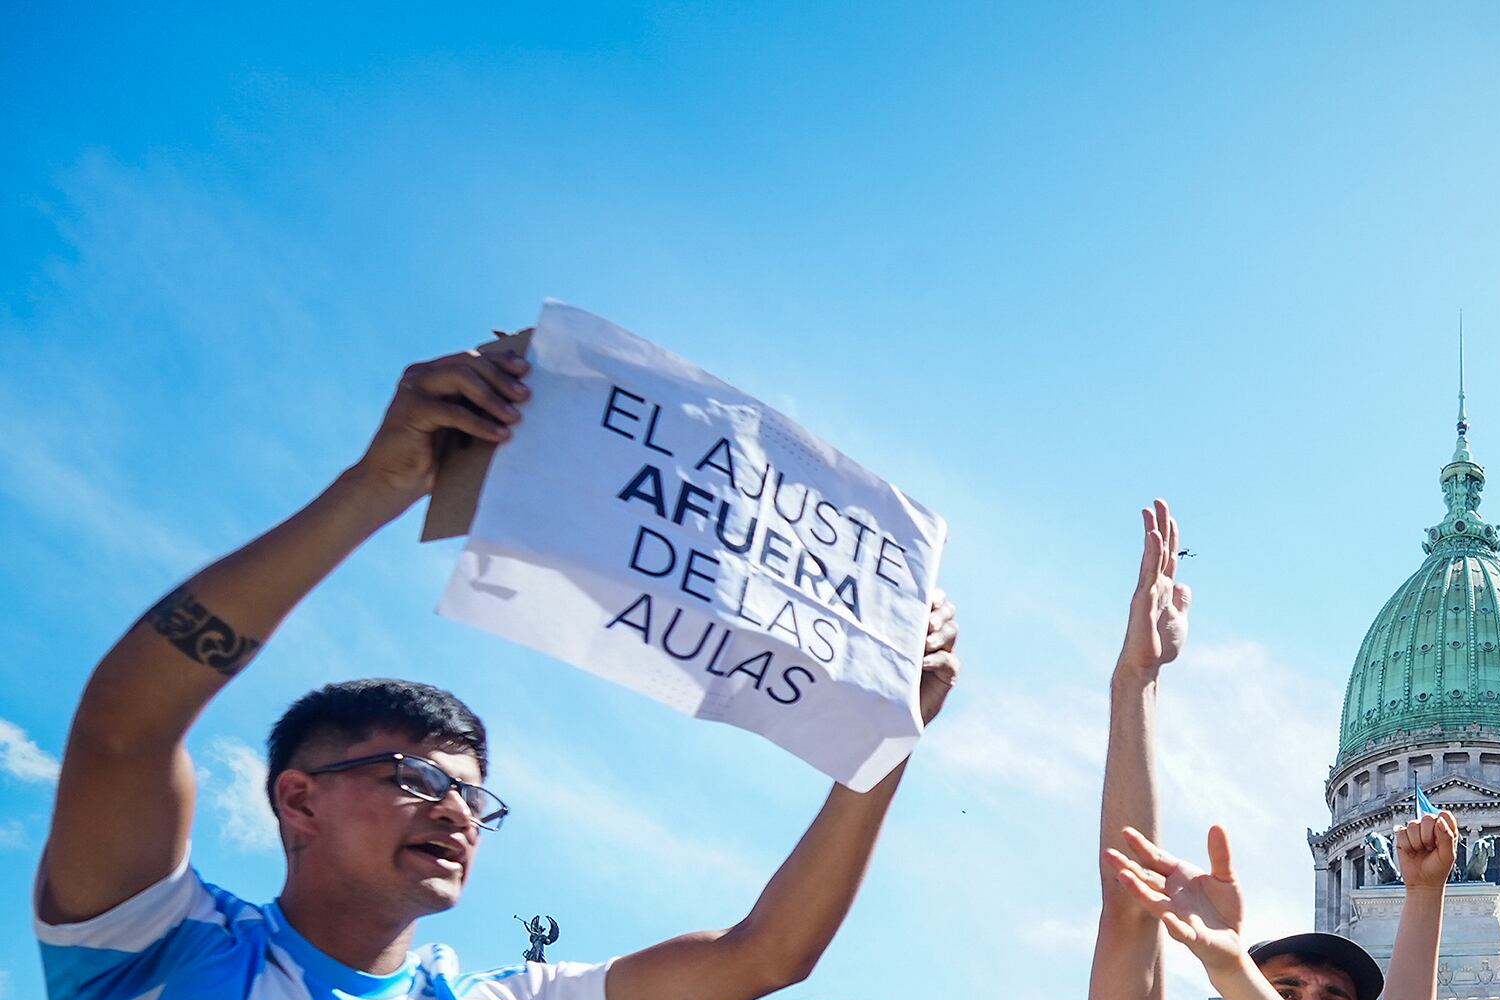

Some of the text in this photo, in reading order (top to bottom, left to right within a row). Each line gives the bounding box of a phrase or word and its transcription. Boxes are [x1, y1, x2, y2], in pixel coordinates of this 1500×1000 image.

[602, 384, 907, 588] EL AJUSTE
[616, 463, 863, 624] AFUERA
[605, 592, 817, 706] AULAS
[629, 525, 839, 664] DE LAS
